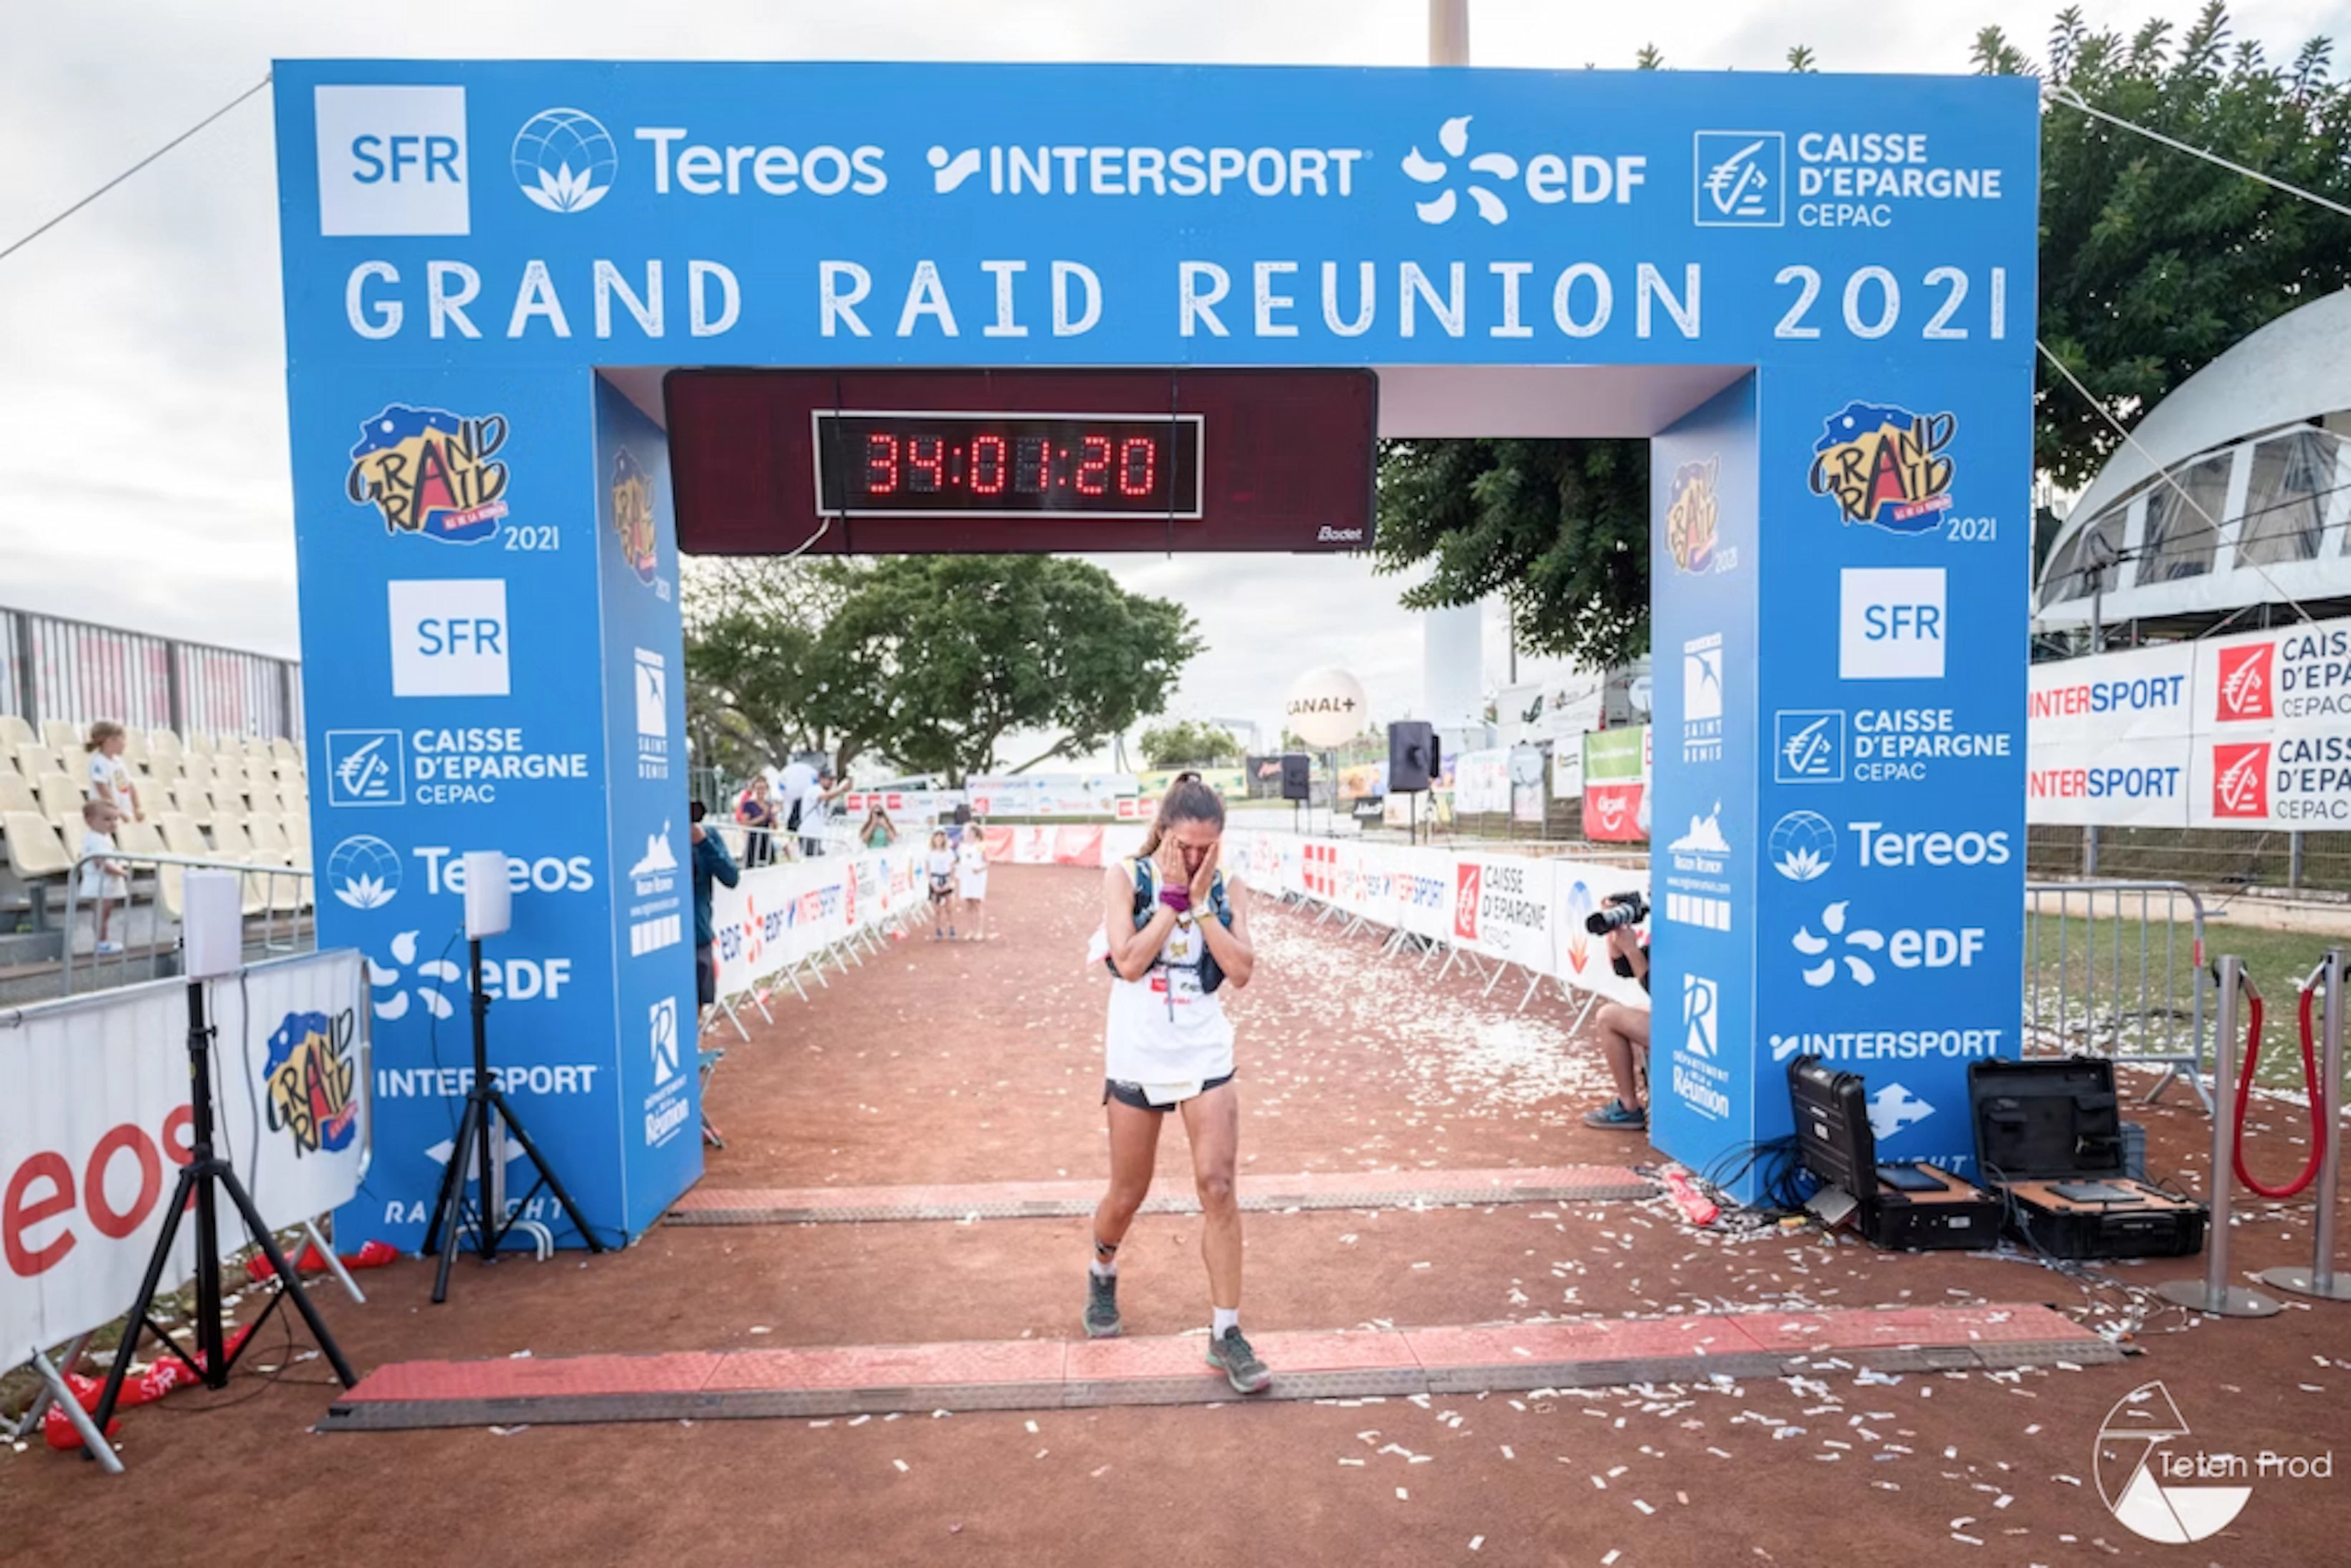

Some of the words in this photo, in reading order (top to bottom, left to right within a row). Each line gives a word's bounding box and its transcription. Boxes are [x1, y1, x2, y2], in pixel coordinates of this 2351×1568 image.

[350, 133, 461, 185] SFR
[634, 128, 888, 196] Tereos
[1797, 133, 1927, 163] CAISSE
[989, 145, 1363, 196] INTERSPORT
[1798, 167, 2002, 199] D'EPARGNE
[1798, 204, 1892, 227] CEPAC
[345, 259, 742, 339] GRAND
[819, 260, 1103, 338] RAID
[1179, 261, 1702, 338] REUNION
[1773, 265, 2006, 340] 2021
[348, 416, 509, 527] GRAND
[867, 433, 1157, 497] 34:01:20
[1809, 413, 1954, 519] GRAND
[1839, 434, 1954, 522] RAID
[381, 439, 508, 530] RAID
[504, 525, 559, 550] 2021
[1947, 517, 1996, 541] 2021
[418, 618, 501, 656] SFR
[1865, 604, 1940, 641] SFR
[2282, 631, 2351, 662] CAIS
[2029, 674, 2185, 719] INTERSPORT
[1854, 709, 1954, 732] CAISSE
[413, 727, 523, 753] CAISSE
[1855, 734, 2011, 758] D'EPARGNE
[415, 754, 589, 780] D'EPARGNE
[1854, 762, 1927, 782] CEPAC
[416, 784, 495, 805] CEPAC
[2031, 768, 2180, 798] NTERSPORT
[2276, 799, 2348, 819] CEPAC
[1848, 822, 2011, 867] Tereos
[412, 846, 594, 894] Teeos
[1483, 865, 1524, 894] CAISSE
[1802, 1030, 2003, 1060] INTERSPORT
